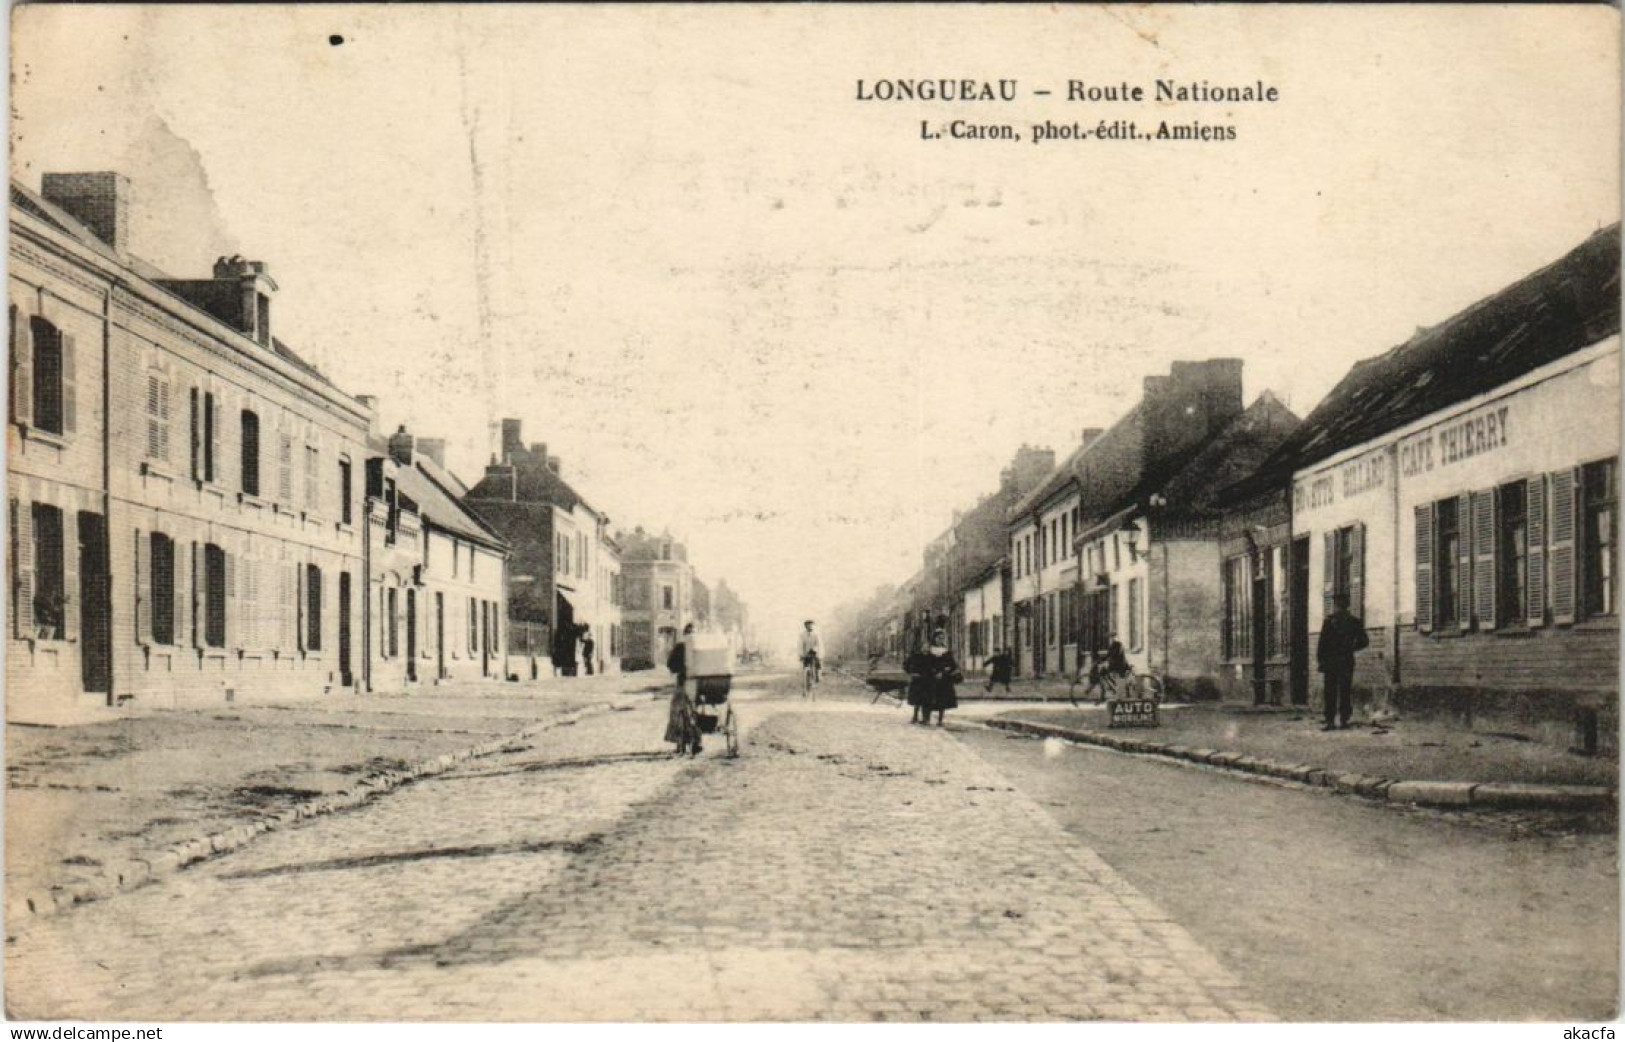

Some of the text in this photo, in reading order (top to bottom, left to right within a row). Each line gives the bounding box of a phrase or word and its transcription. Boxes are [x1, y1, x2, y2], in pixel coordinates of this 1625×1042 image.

[1439, 405, 1508, 466] THIERRY
[1343, 456, 1384, 498] BILLARD
[1115, 701, 1152, 713] AUTO
